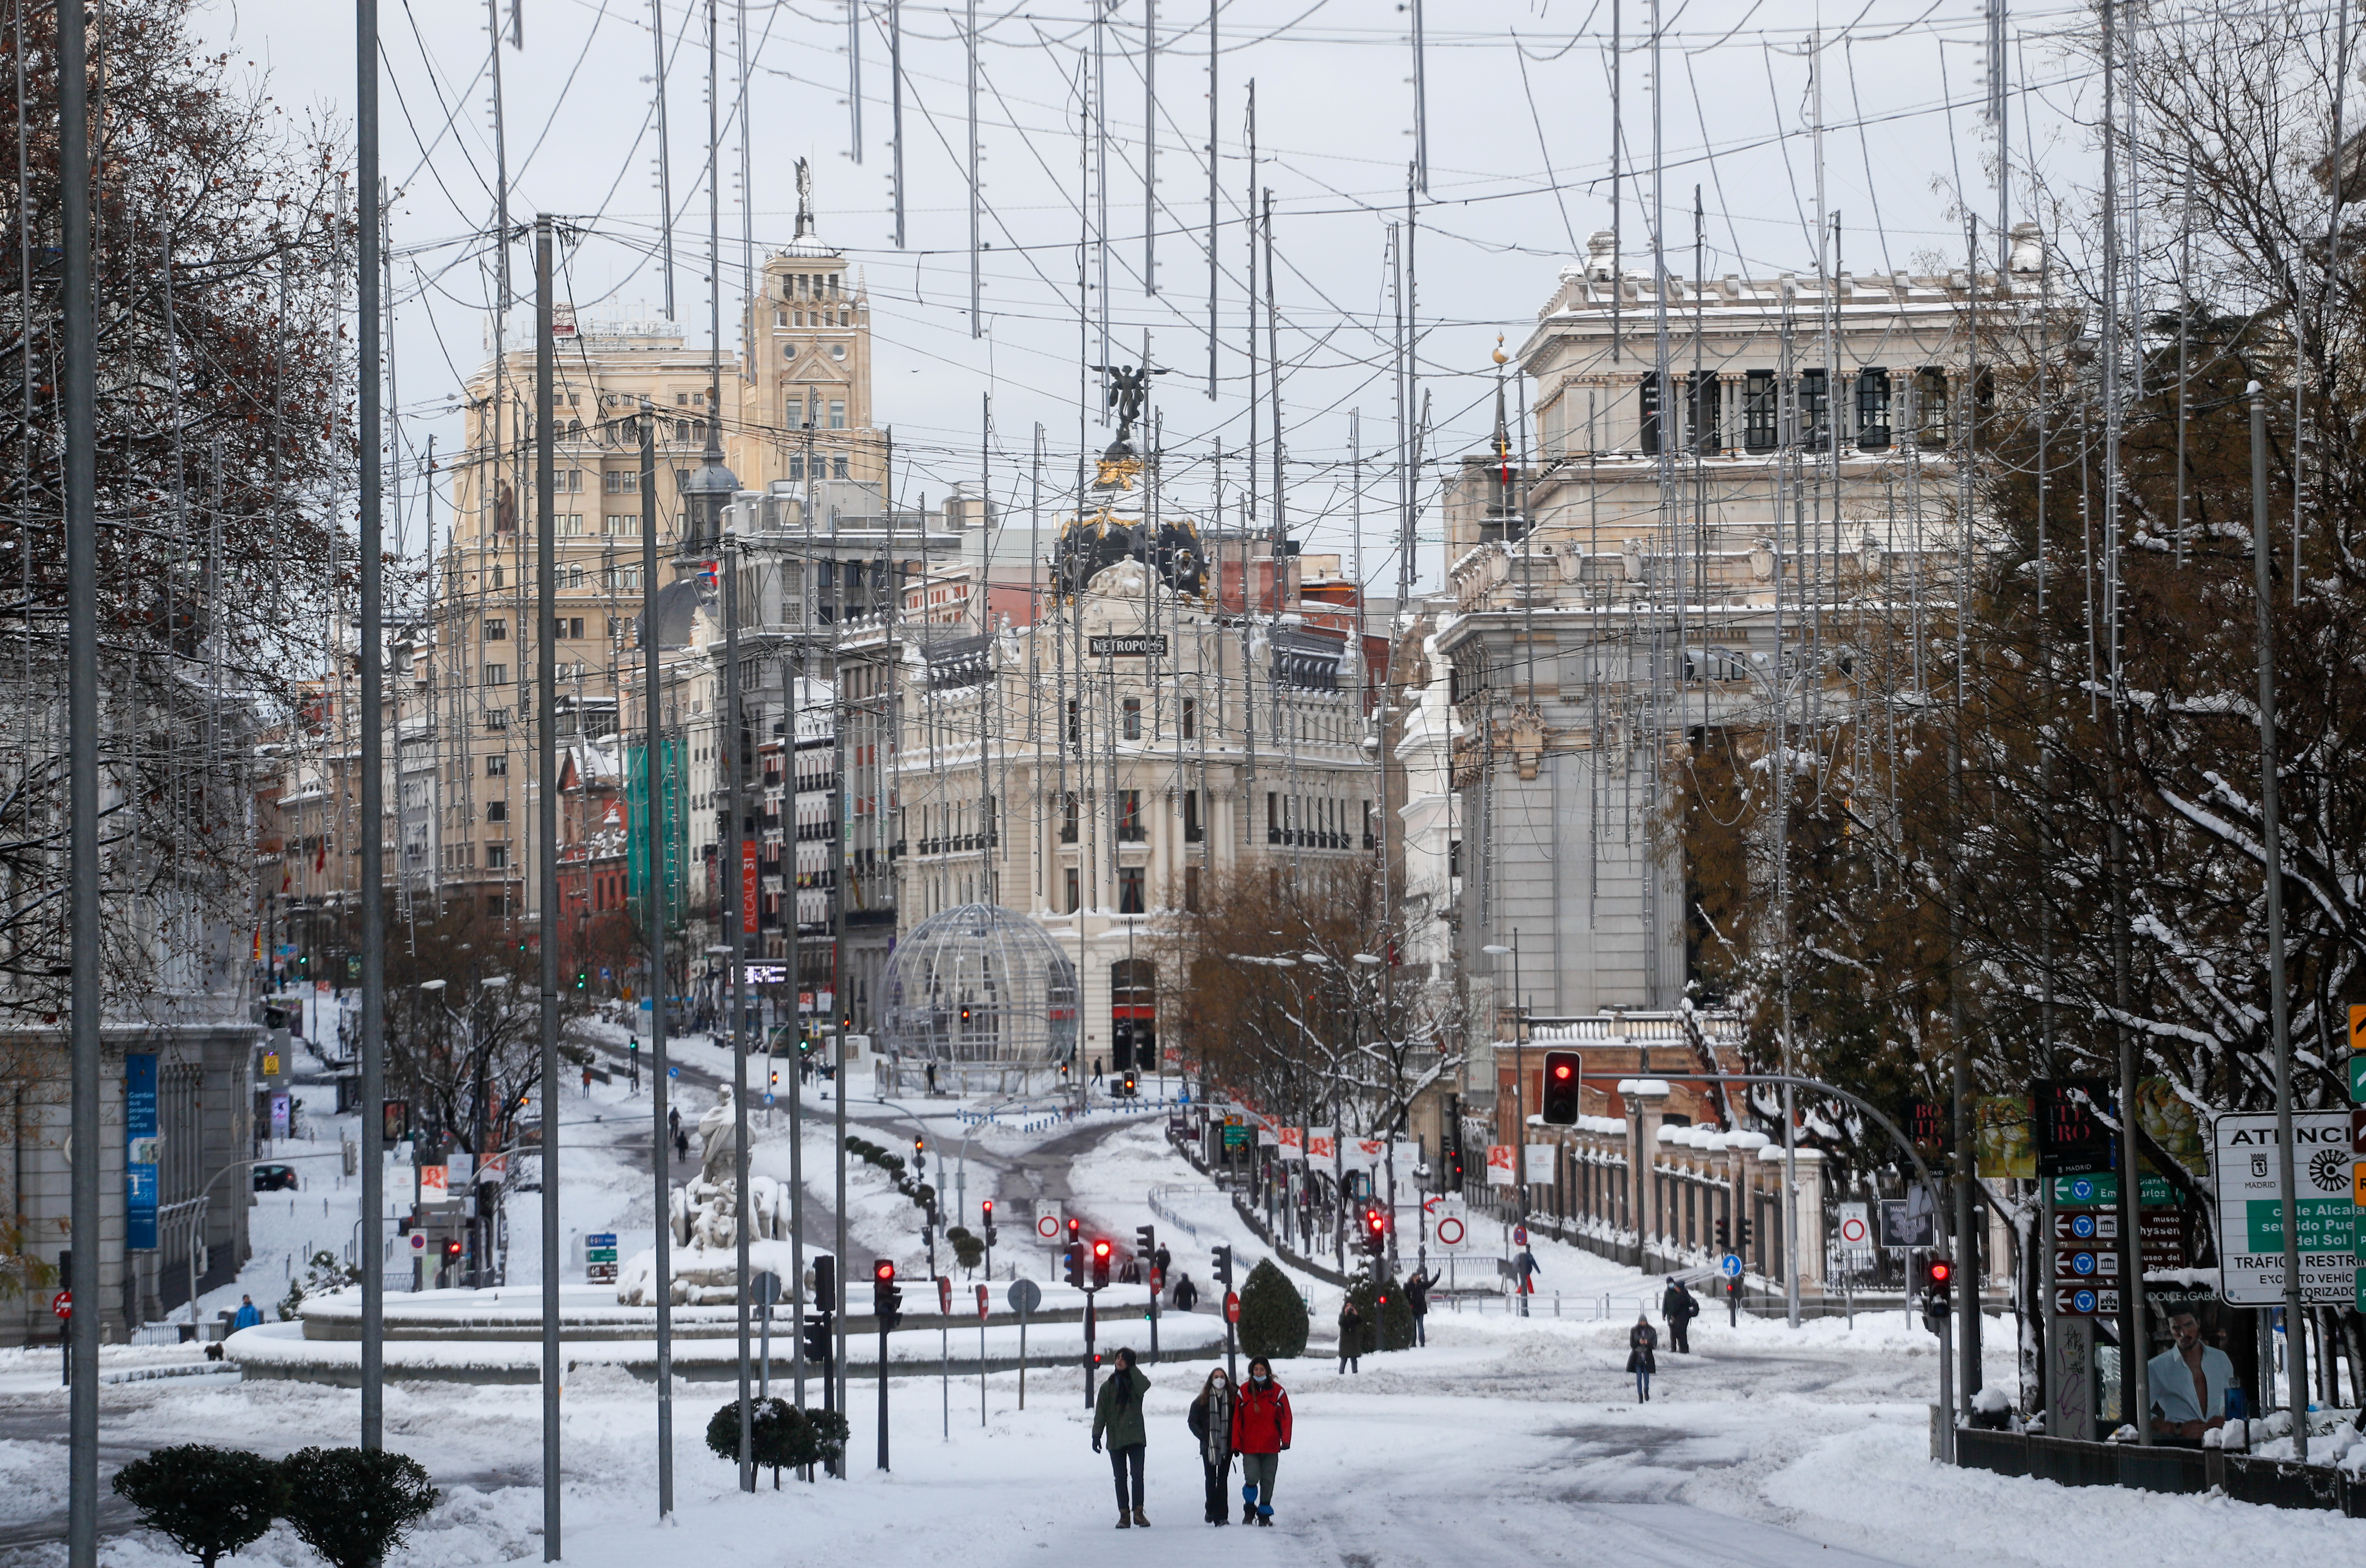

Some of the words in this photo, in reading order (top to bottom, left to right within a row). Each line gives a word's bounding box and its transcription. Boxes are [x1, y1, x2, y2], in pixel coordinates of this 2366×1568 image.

[744, 858, 754, 870] 31
[744, 877, 755, 926] ALCALA
[2058, 1124, 2091, 1142] RO
[2273, 1205, 2311, 1217] cle
[2262, 1220, 2320, 1232] seido
[2323, 1234, 2347, 1245] Sol
[2234, 1254, 2300, 1269] TRÁFIC
[2149, 1291, 2181, 1301] DOLCE
